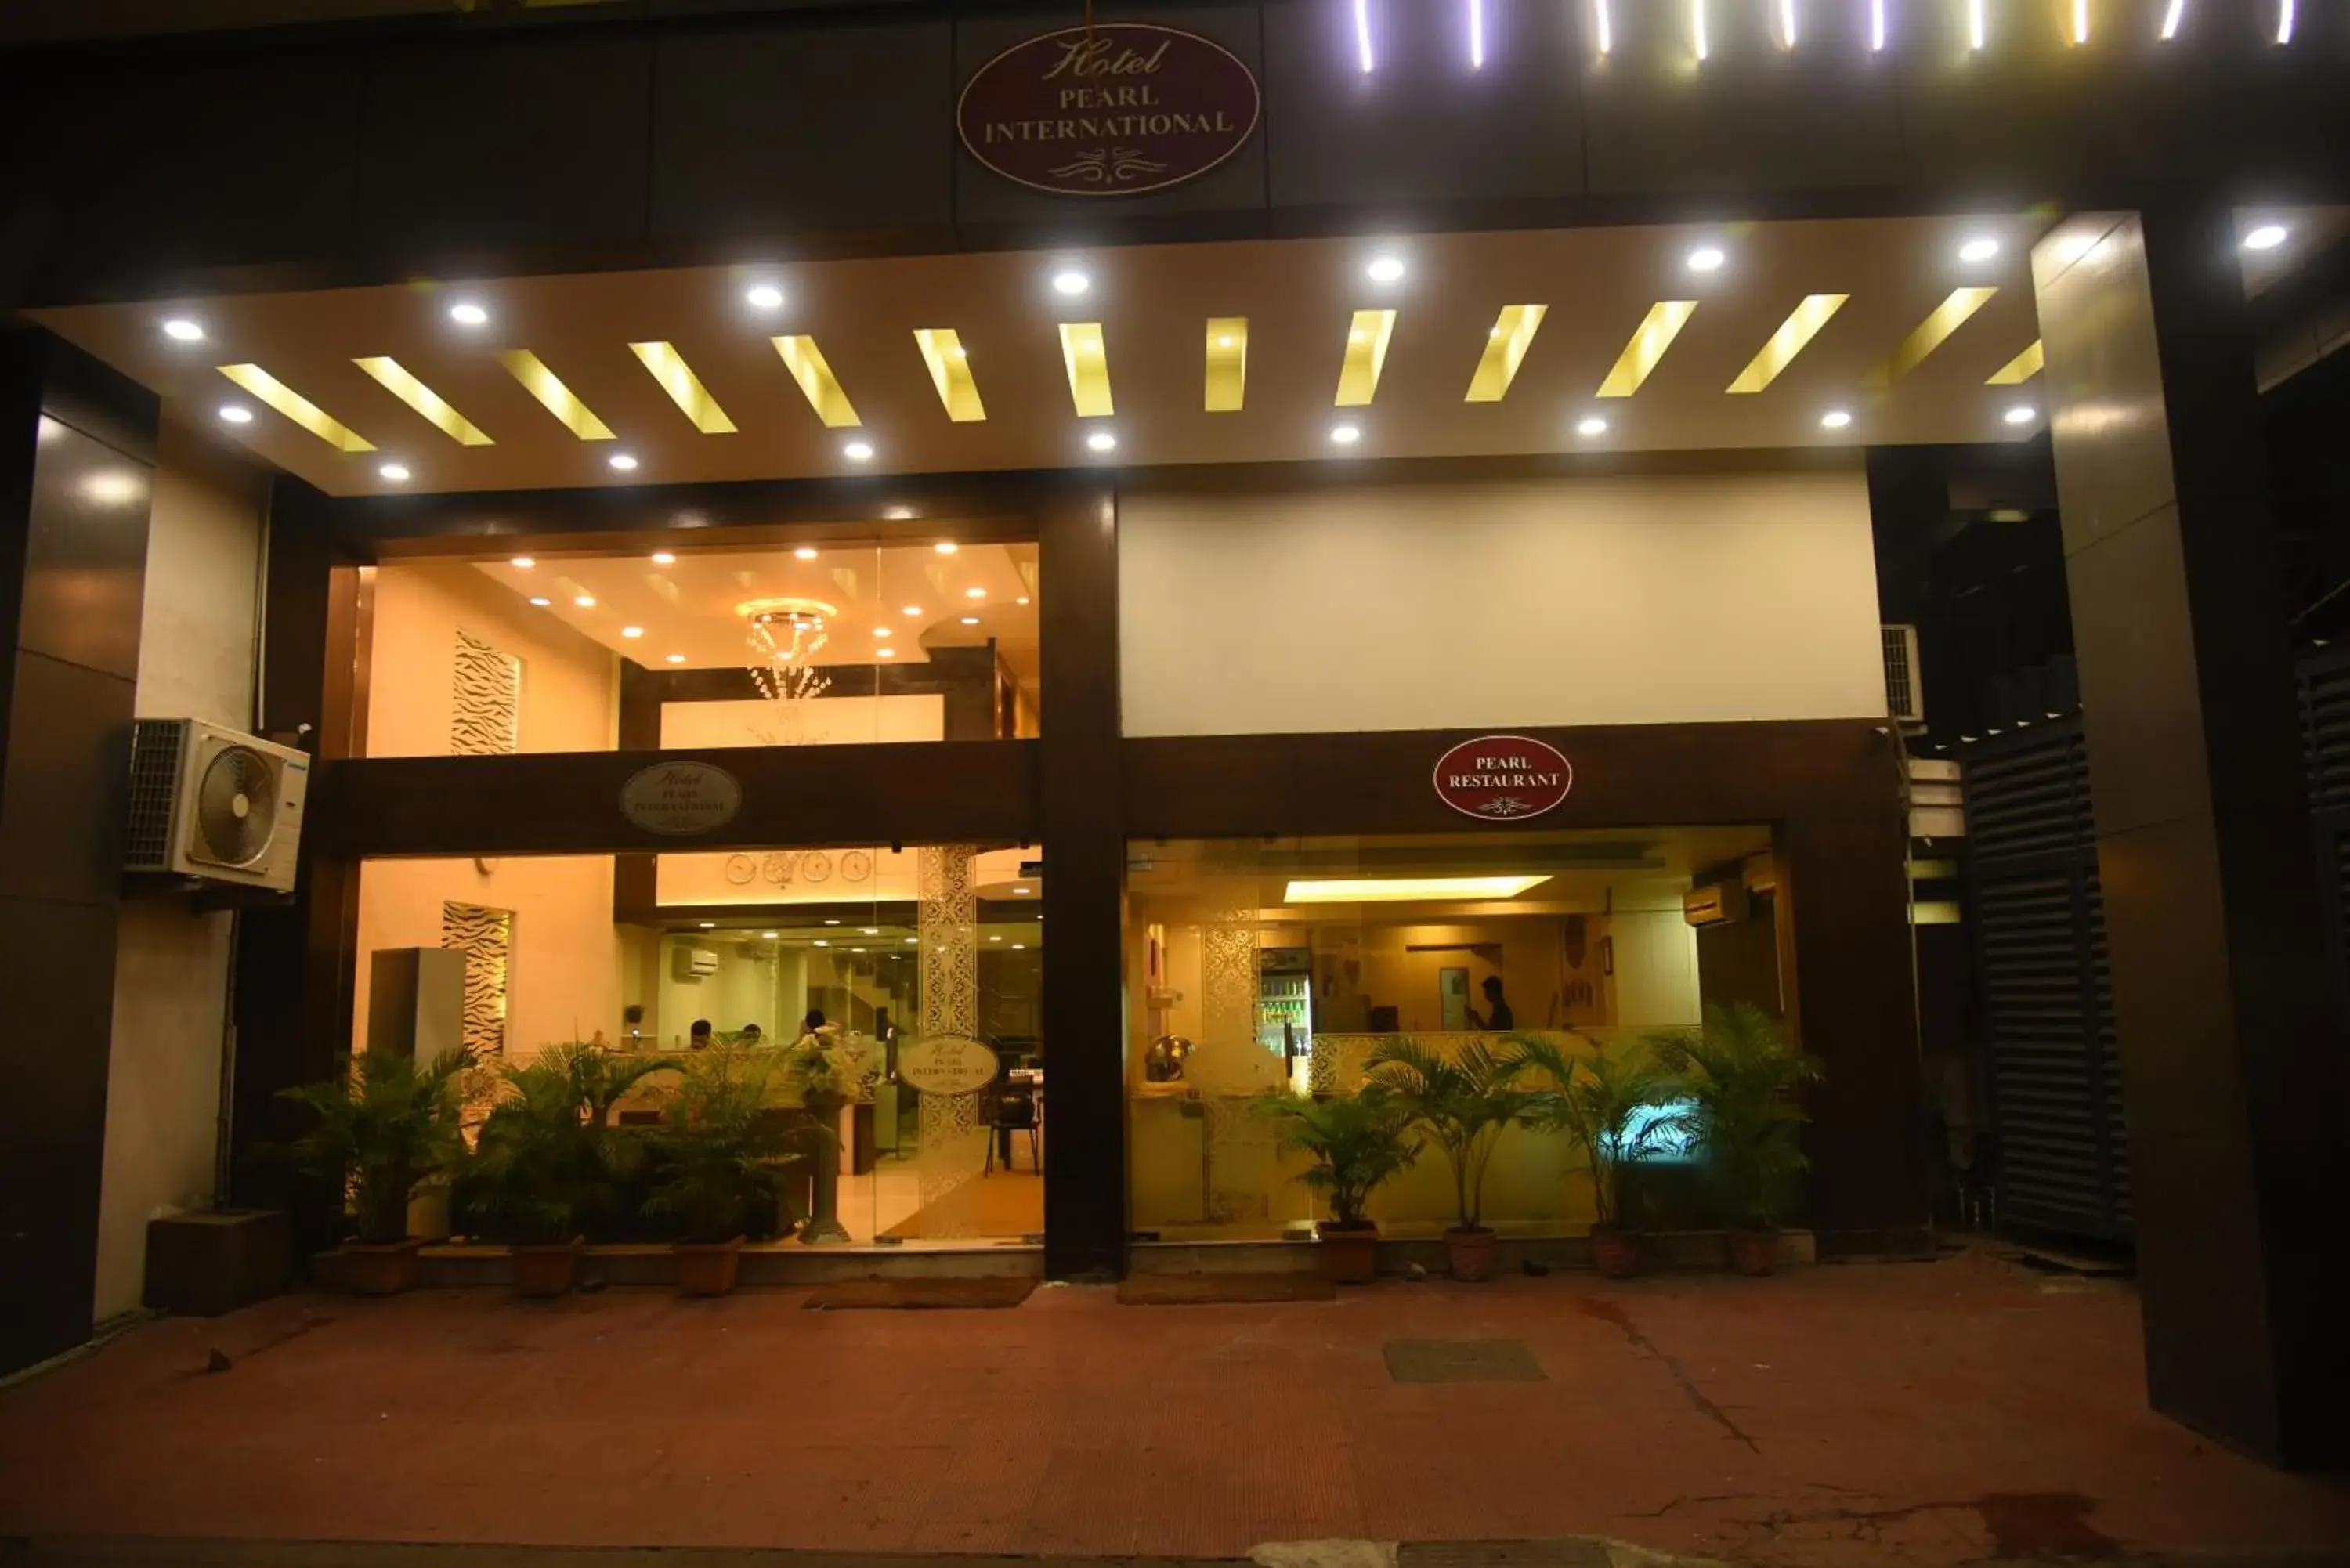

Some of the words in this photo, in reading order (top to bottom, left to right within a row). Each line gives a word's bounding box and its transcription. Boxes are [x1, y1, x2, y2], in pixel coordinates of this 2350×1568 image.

[1042, 38, 1171, 80] Hotel
[1059, 85, 1159, 110] PEARL
[985, 111, 1235, 143] INTERNATIONAL
[1476, 757, 1532, 771] PEARL
[1449, 773, 1560, 788] RESTAURANT
